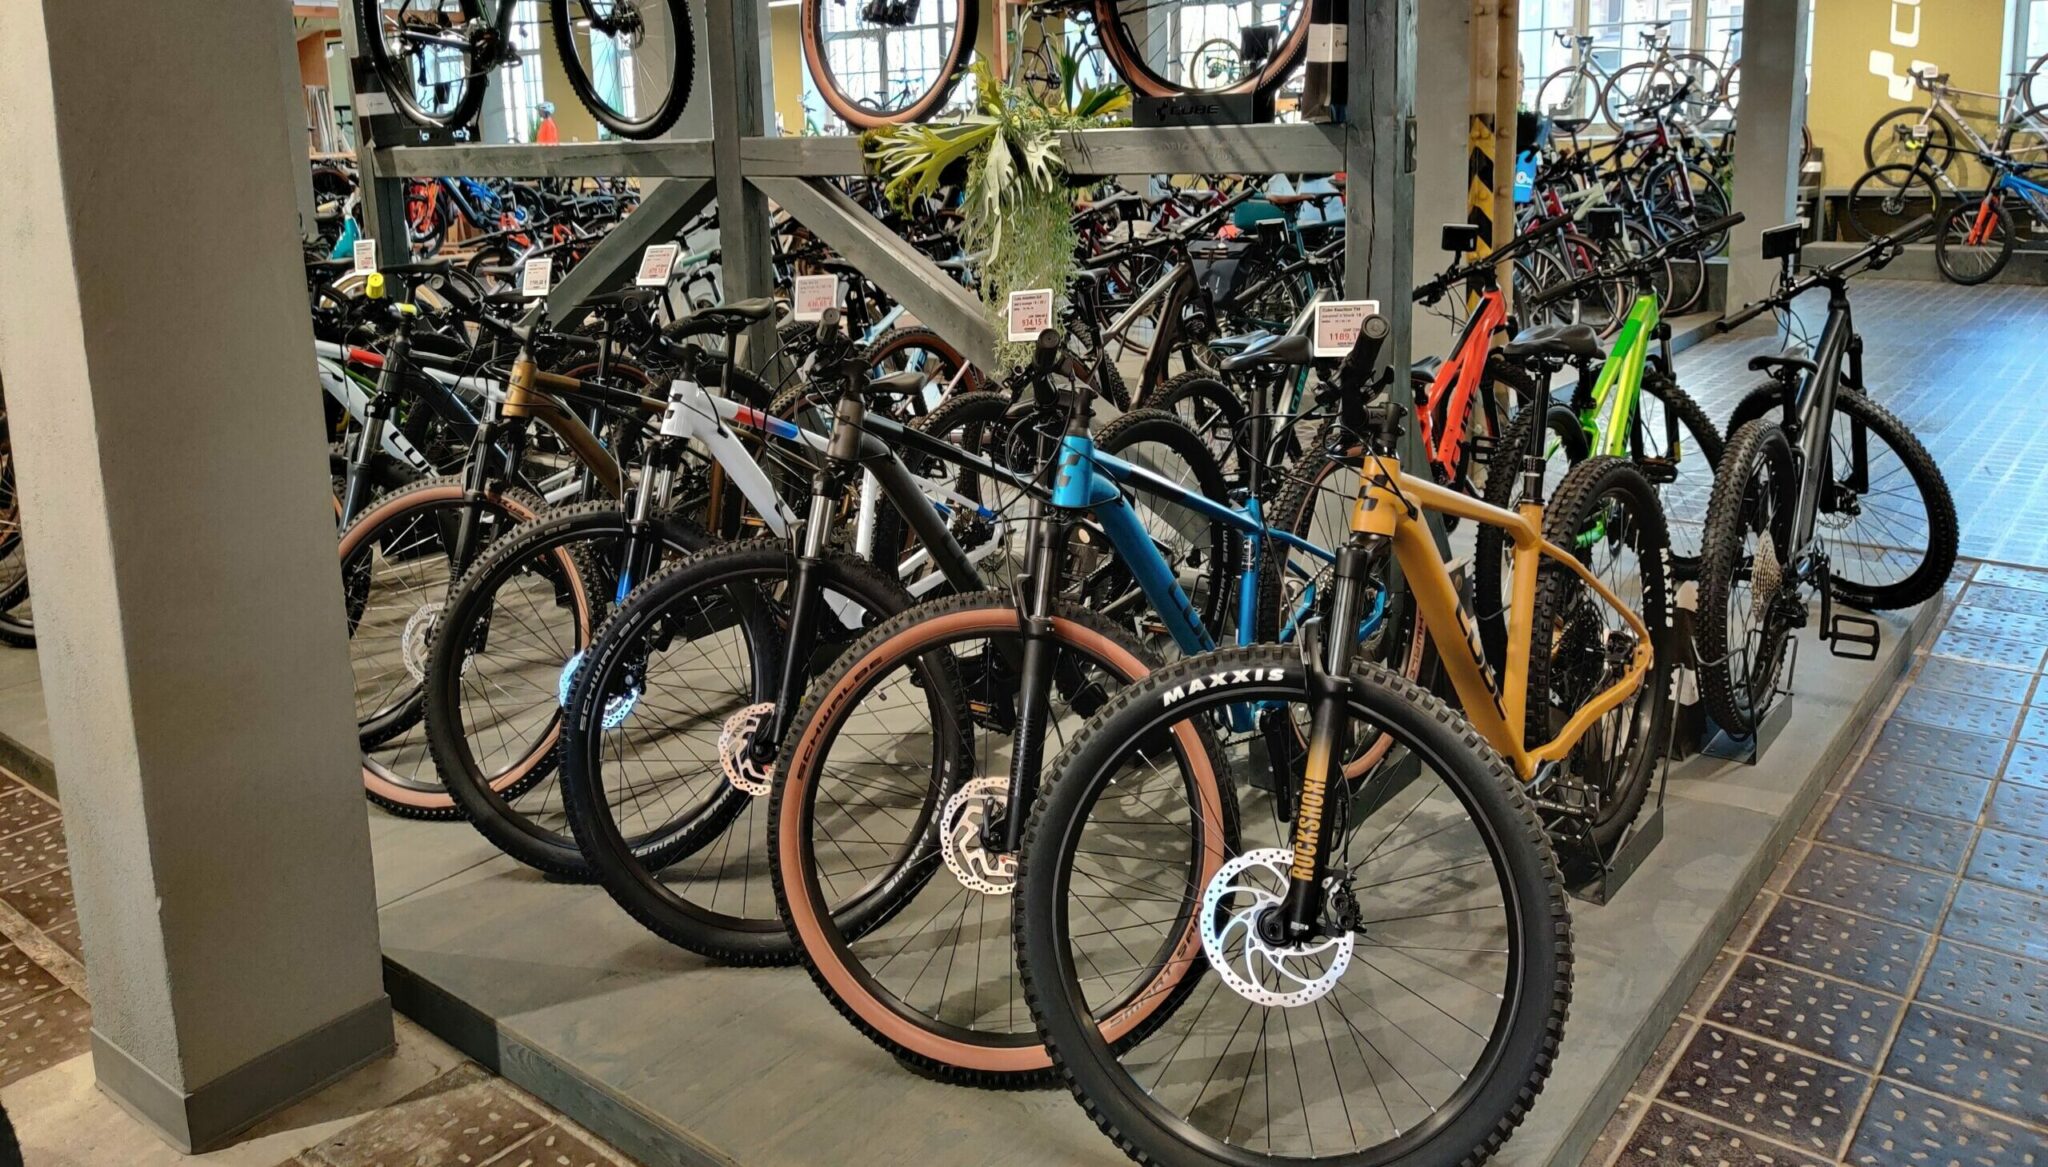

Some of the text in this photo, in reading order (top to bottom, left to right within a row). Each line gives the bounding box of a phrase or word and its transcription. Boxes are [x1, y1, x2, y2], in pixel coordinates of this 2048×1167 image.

[1169, 104, 1220, 116] CUBE
[1329, 332, 1357, 341] 1189,1
[388, 430, 437, 479] CU
[579, 610, 642, 732] SCHWALBE
[1163, 668, 1286, 707] MAXXIS
[797, 655, 884, 780] SCHWALBE
[1291, 779, 1326, 882] ROCKSHOX
